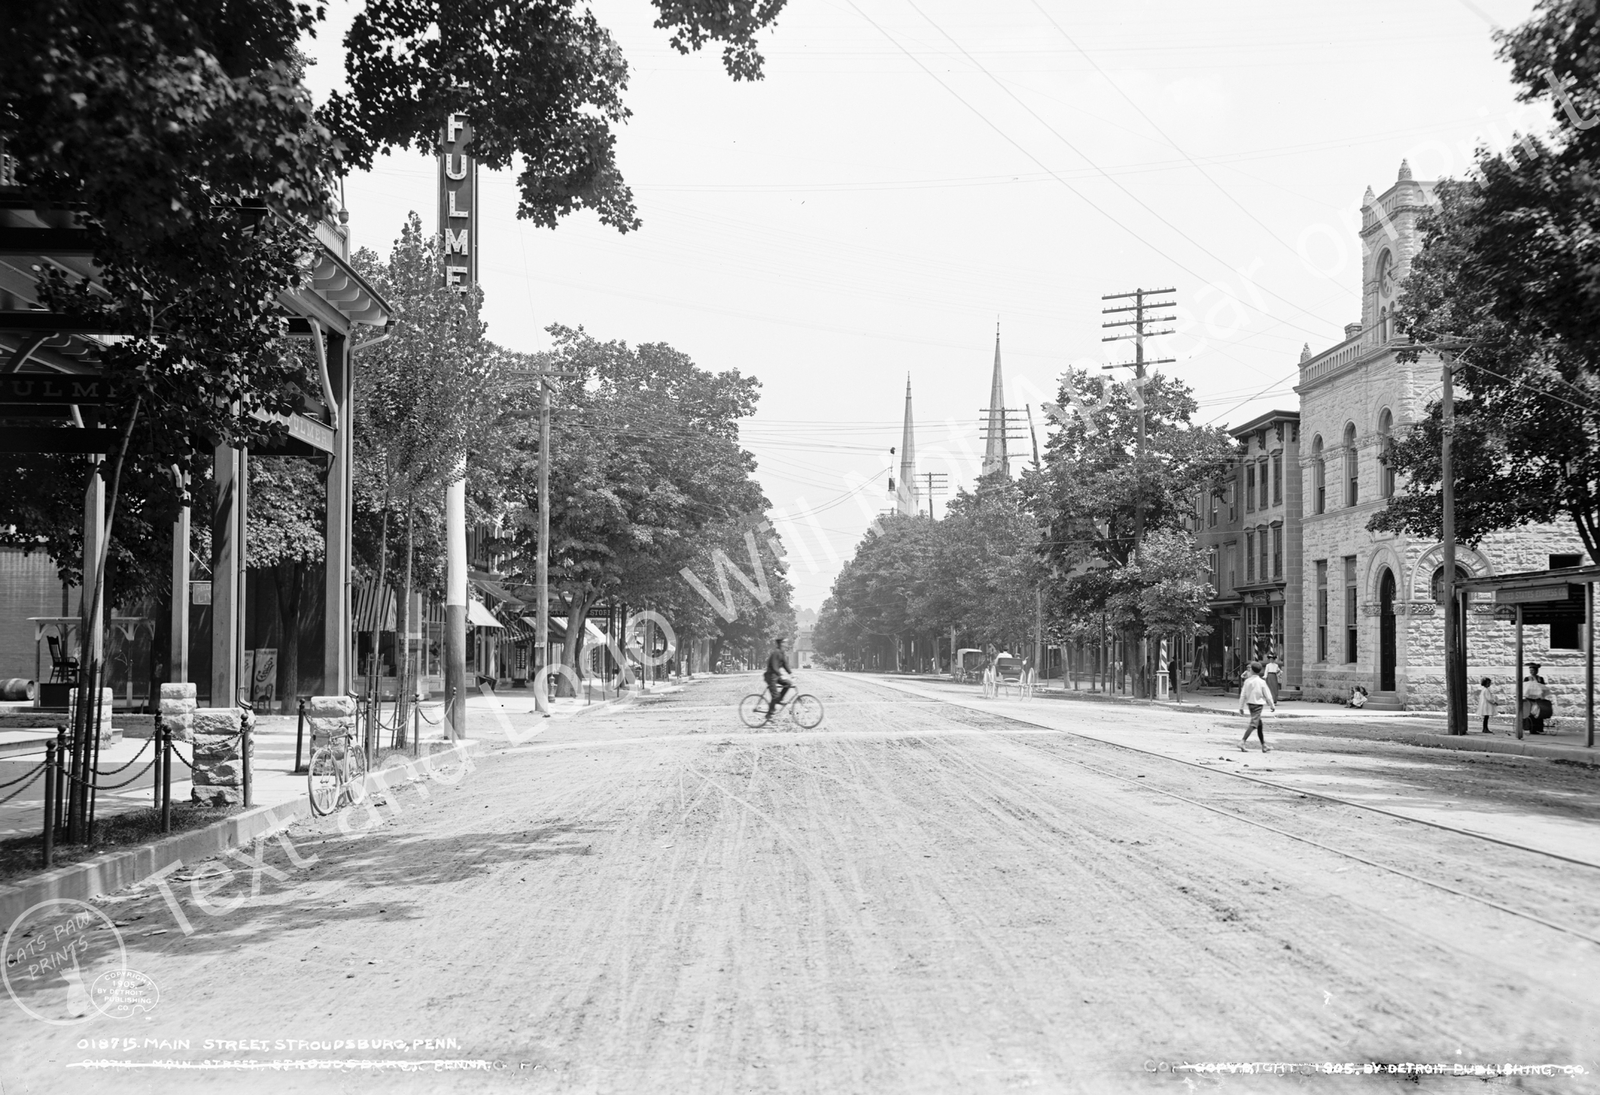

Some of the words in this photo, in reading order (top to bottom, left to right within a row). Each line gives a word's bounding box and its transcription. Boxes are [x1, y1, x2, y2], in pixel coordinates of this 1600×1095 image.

[0, 381, 117, 398] ULM
[1515, 590, 1535, 600] STATES
[1535, 588, 1557, 598] EXPRESS
